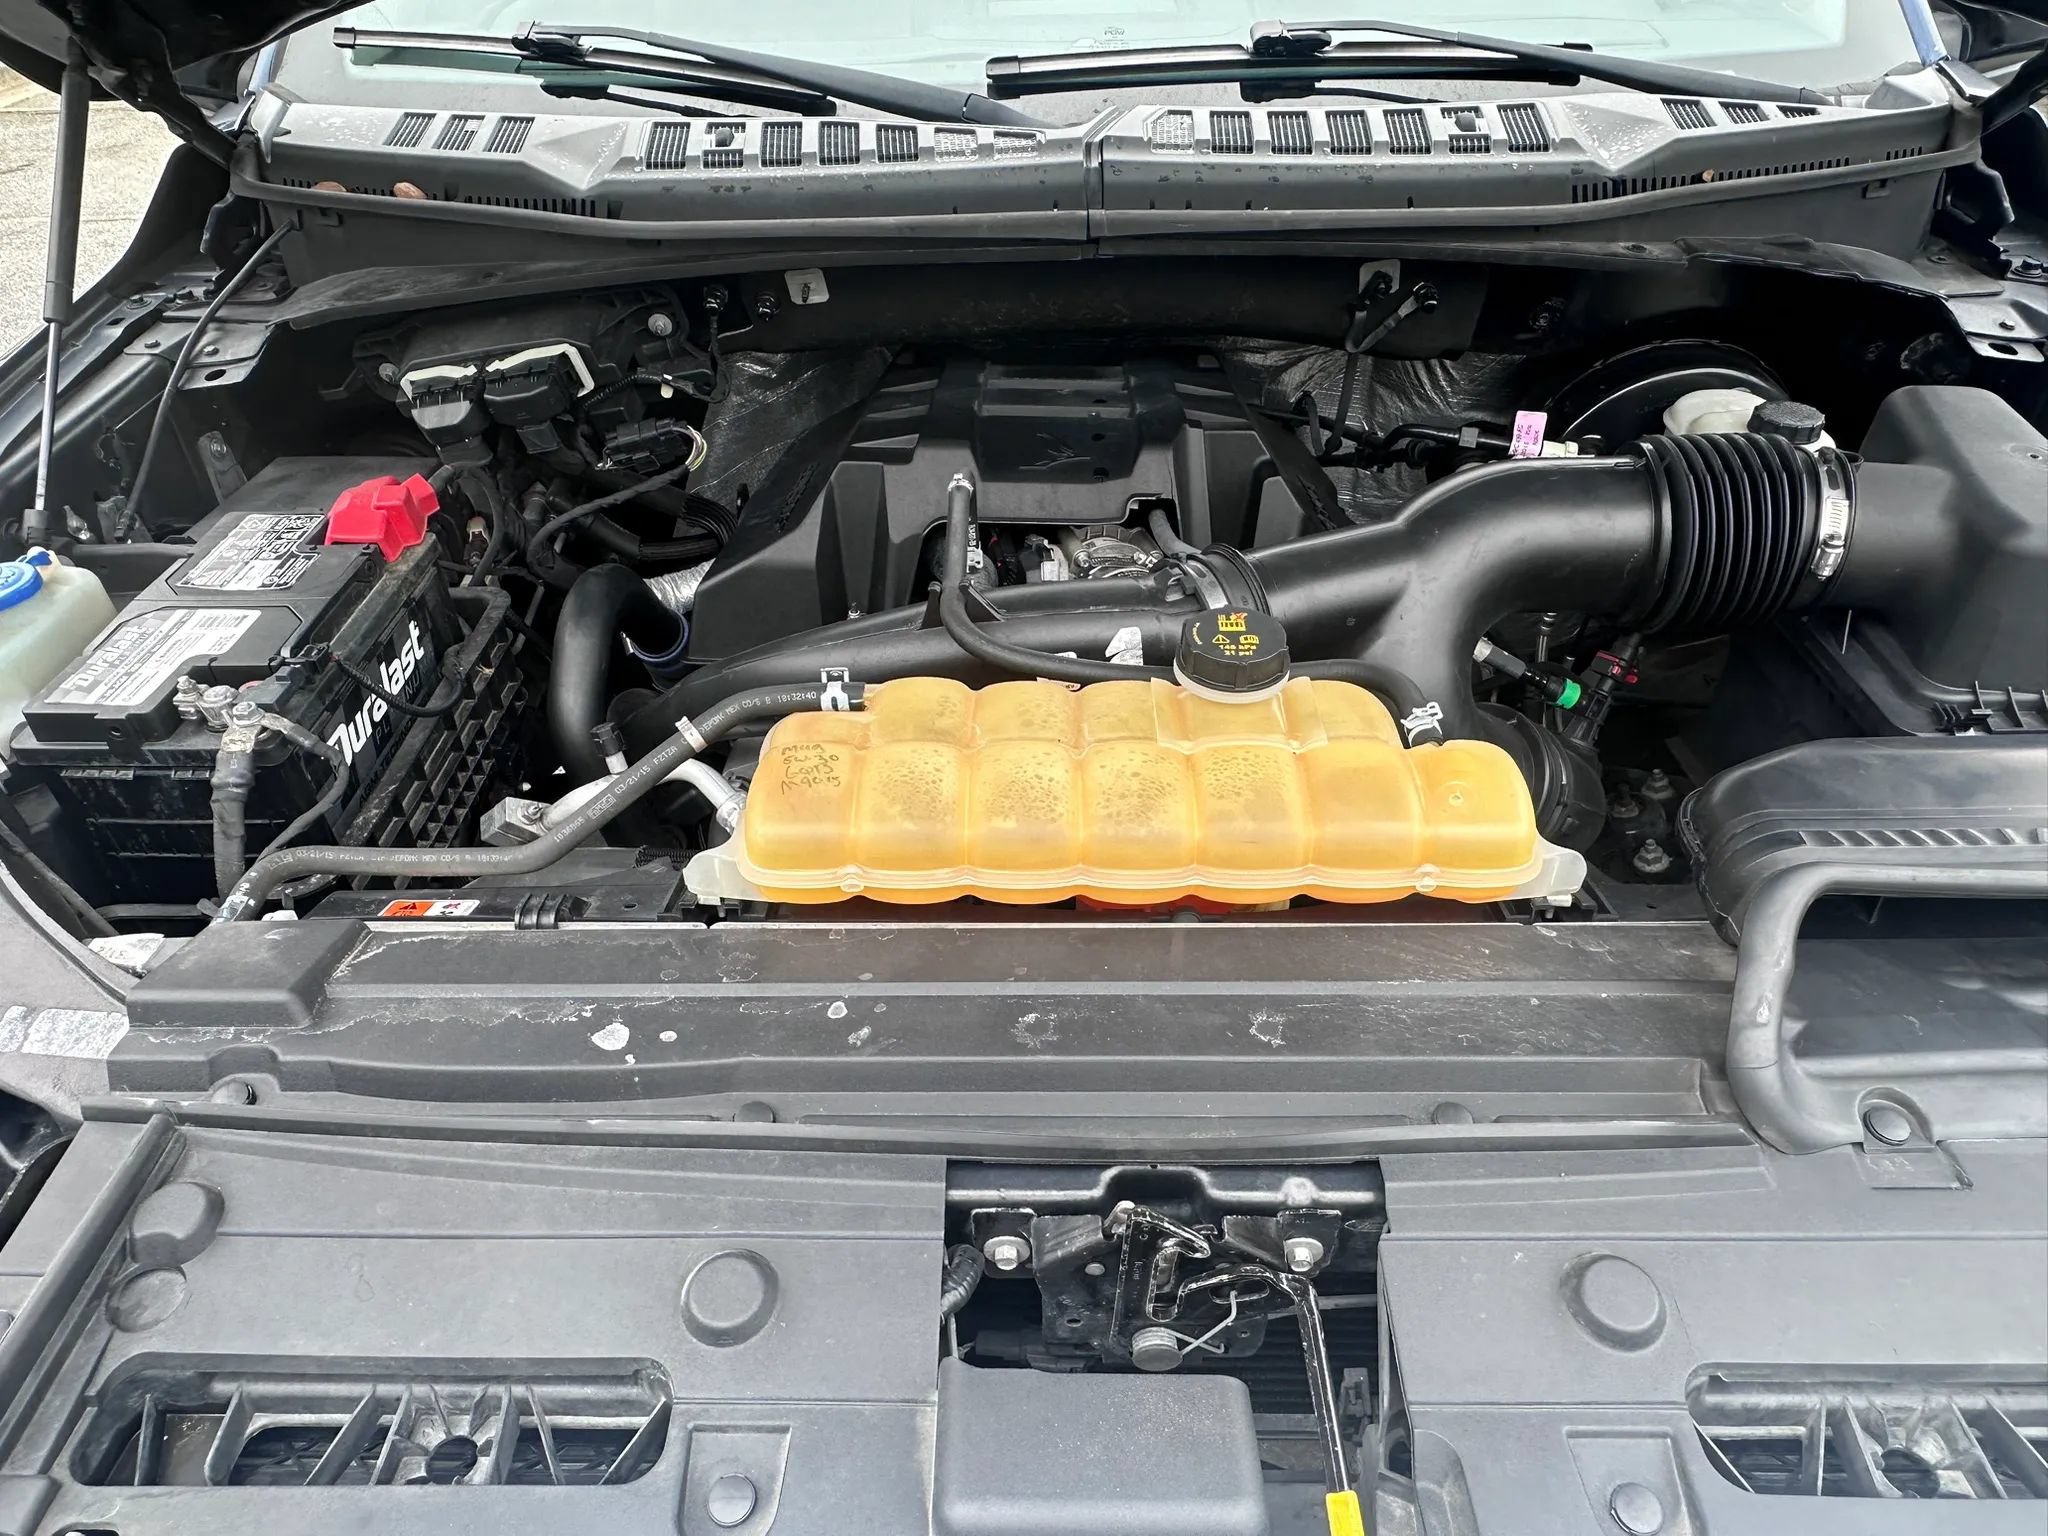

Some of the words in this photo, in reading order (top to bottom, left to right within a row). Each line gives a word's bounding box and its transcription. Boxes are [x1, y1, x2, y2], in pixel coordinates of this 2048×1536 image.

[59, 625, 147, 689] Duralast
[326, 619, 424, 767] Duralast
[725, 704, 741, 715] MEX
[614, 764, 651, 794] 03/21/15
